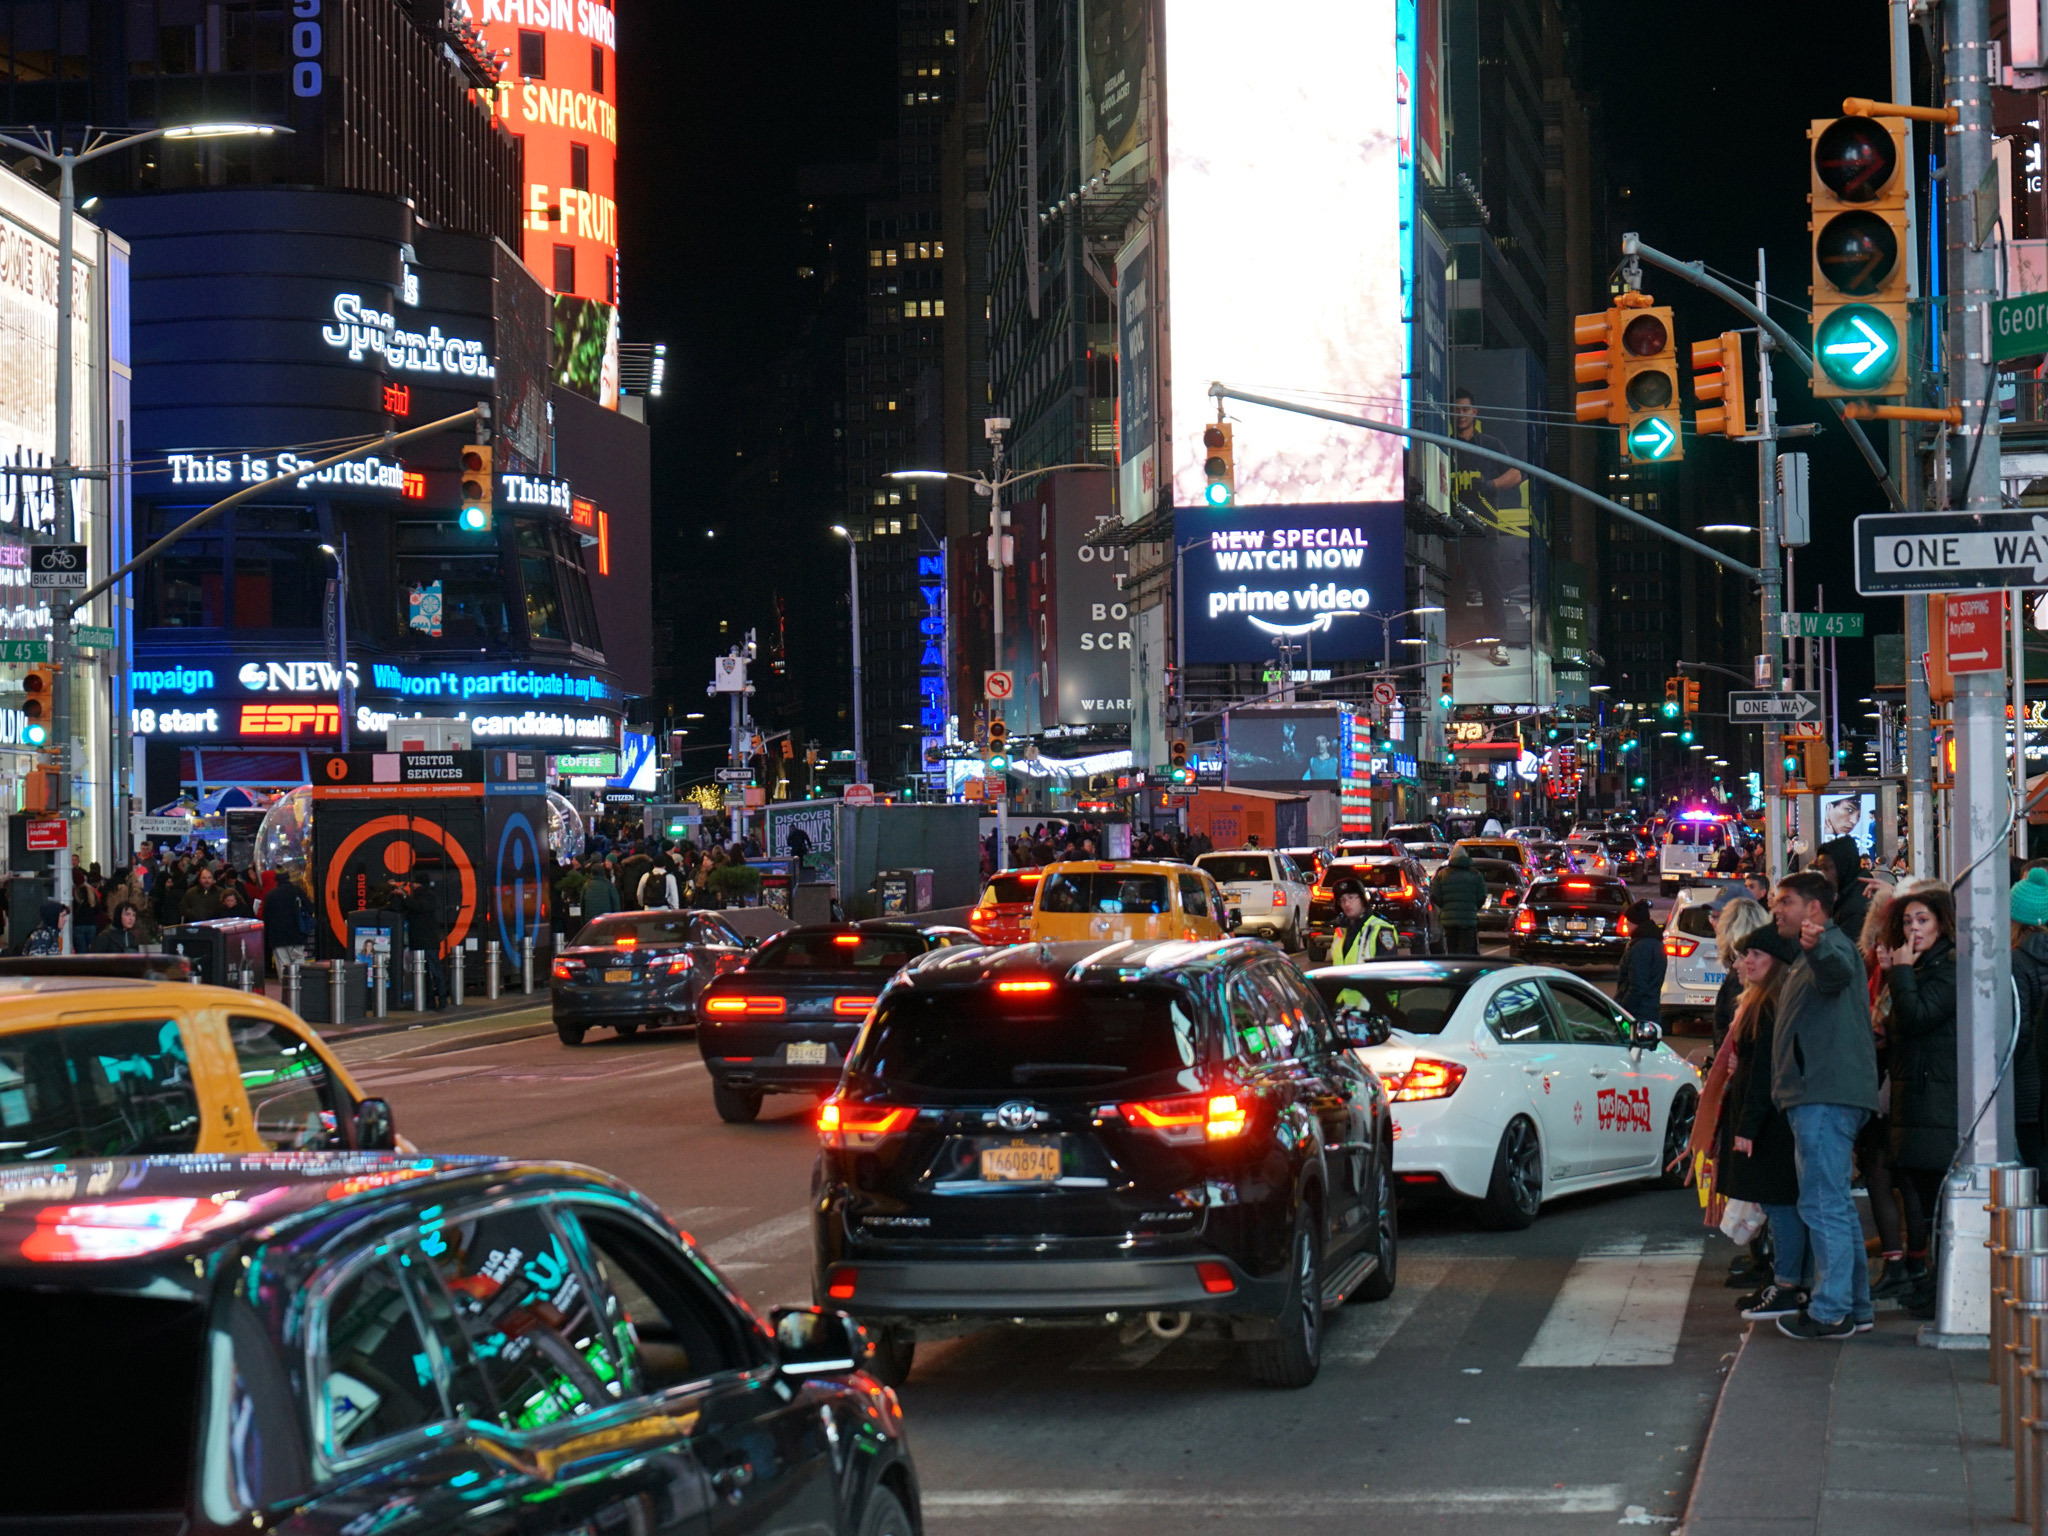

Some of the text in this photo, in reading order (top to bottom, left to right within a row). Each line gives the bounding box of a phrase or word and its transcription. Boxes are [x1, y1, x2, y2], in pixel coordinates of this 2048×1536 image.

[523, 84, 598, 134] SNACK
[168, 454, 233, 484] This
[240, 453, 268, 482] is
[502, 474, 549, 504] This
[550, 480, 562, 507] is
[1211, 527, 1368, 549] NEW SPECIAL
[1215, 549, 1364, 571] WATCH NOW
[1893, 538, 1961, 568] ONE
[33, 574, 55, 585] BIKE
[58, 574, 84, 585] LANE
[1209, 583, 1370, 619] prime video
[1949, 600, 1990, 618] NO STOPPING
[327, 593, 337, 655] FROZEN
[1804, 616, 1861, 634] W 45 St
[1949, 621, 1976, 638] Anytime
[79, 627, 114, 649] Broadway
[14, 643, 32, 660] 45
[37, 643, 48, 654] St
[266, 662, 360, 691] NEWS
[462, 670, 563, 698] participate
[564, 672, 575, 695] in
[575, 678, 590, 701] any
[1743, 701, 1808, 713] ONE WAY
[159, 708, 218, 733] start
[239, 704, 341, 735] ESPN
[471, 711, 563, 736] candidate
[564, 713, 575, 736] to
[407, 755, 454, 766] VISITOR
[561, 757, 602, 767] COFFEE
[407, 768, 463, 779] SERVICES
[606, 794, 635, 802] CITIZEN
[775, 809, 831, 825] DISCOVER
[987, 1151, 1054, 1172] T660894C
